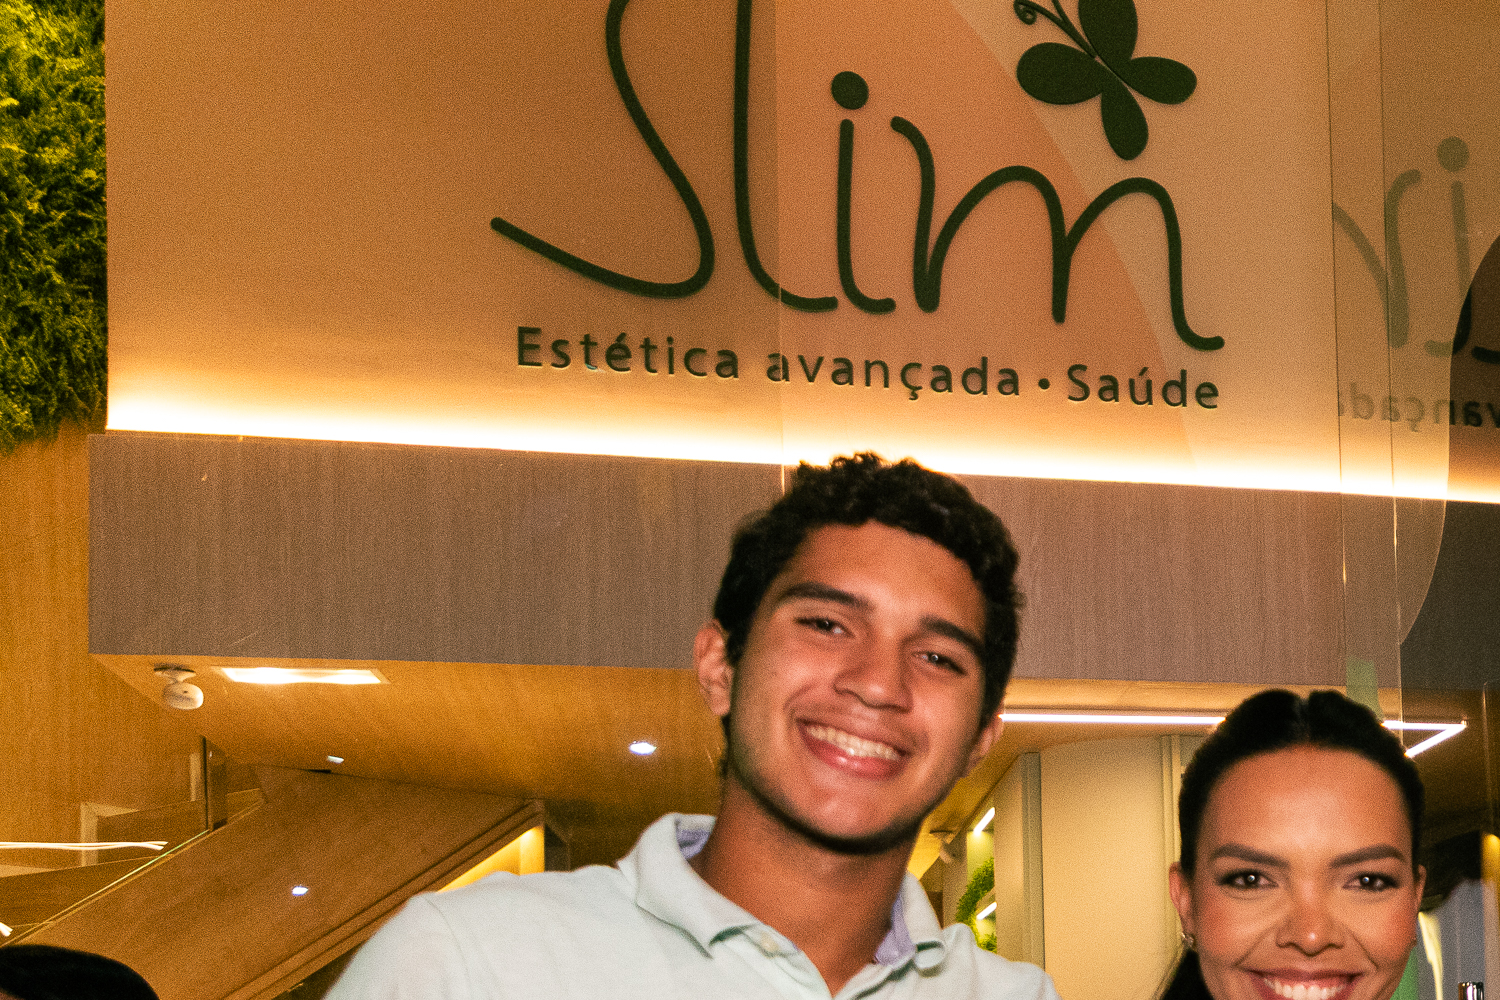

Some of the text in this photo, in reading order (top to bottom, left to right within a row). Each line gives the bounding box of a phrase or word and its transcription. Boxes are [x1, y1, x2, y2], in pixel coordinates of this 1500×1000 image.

[490, 0, 1226, 352] Slim
[516, 325, 1220, 410] Estética avançada Saúde
